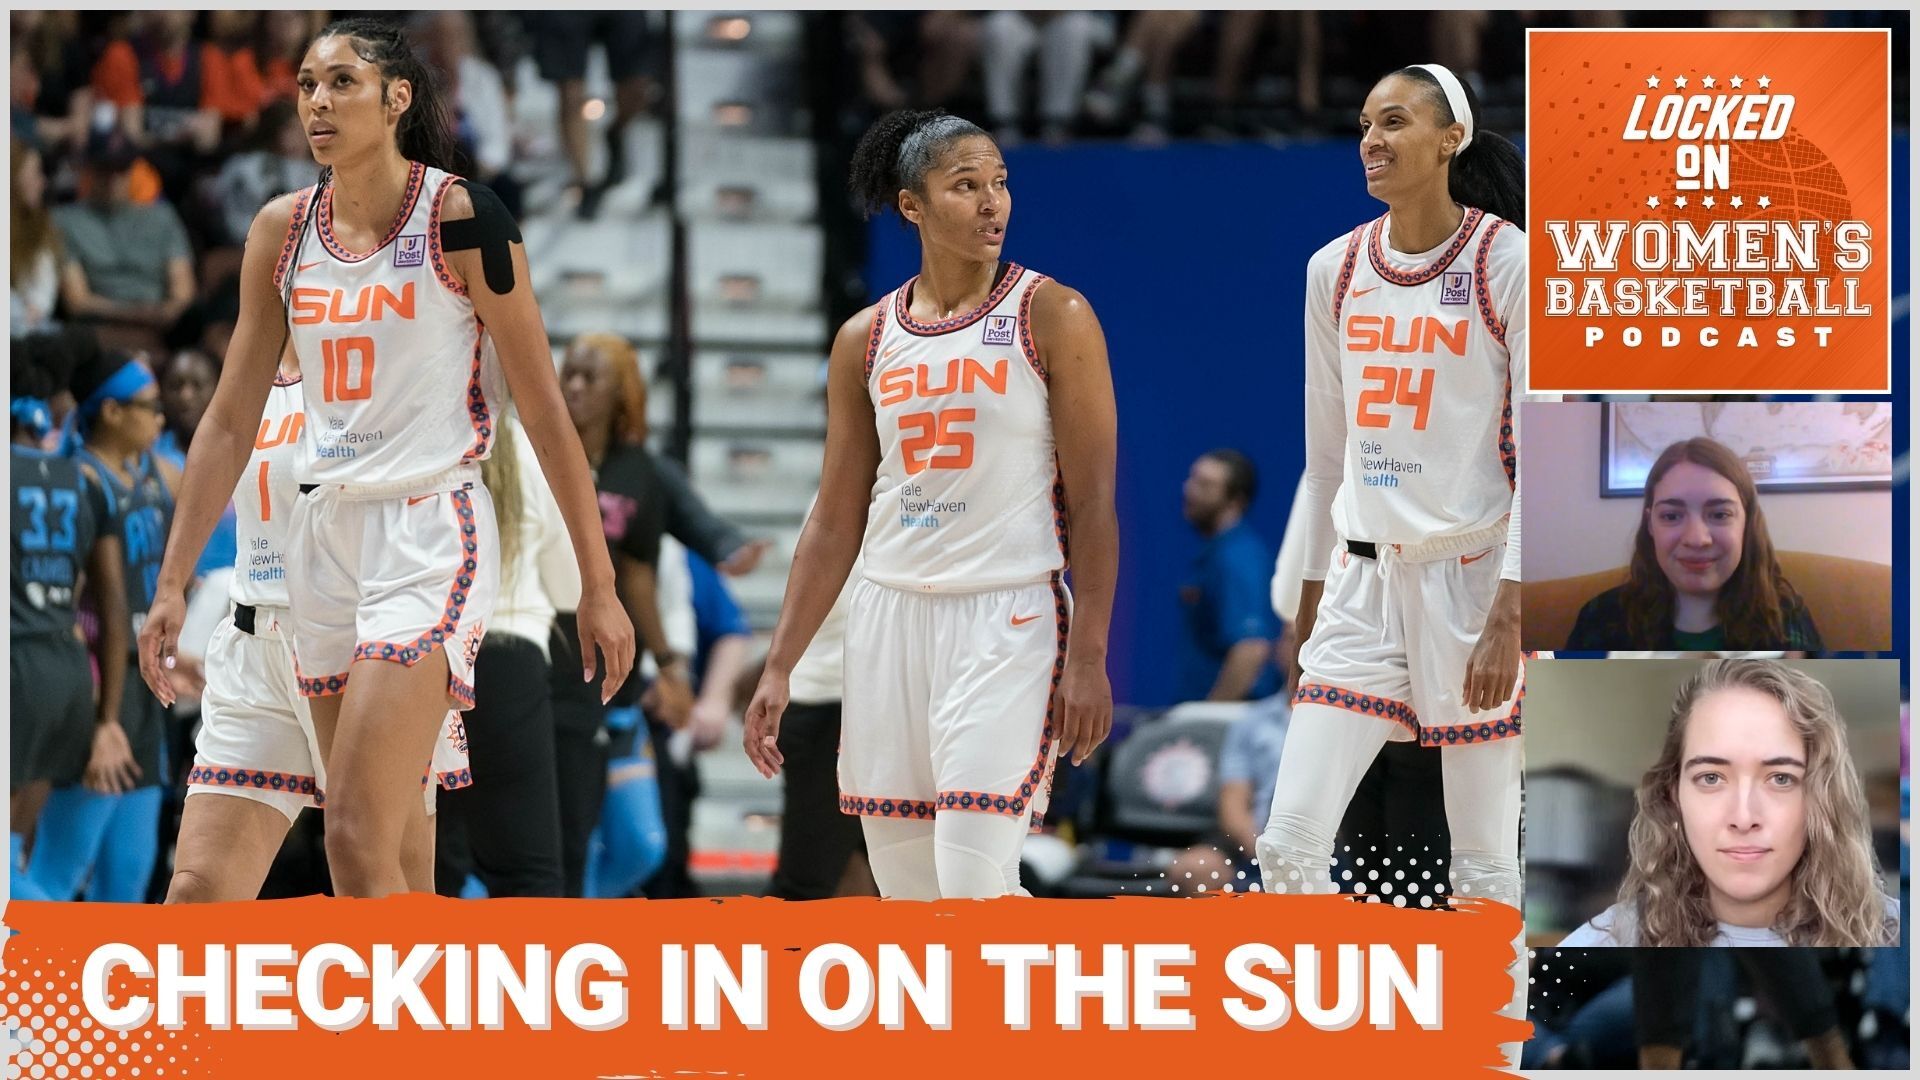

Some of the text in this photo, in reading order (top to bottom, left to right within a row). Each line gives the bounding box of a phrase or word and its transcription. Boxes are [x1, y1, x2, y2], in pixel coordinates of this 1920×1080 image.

[398, 250, 421, 260] Post
[292, 281, 415, 325] SUN
[1445, 287, 1466, 297] Post
[987, 329, 1011, 338] Post
[1347, 315, 1470, 356] SUN
[321, 336, 375, 402] 10
[879, 358, 1009, 407] SUN
[1356, 366, 1435, 430] 24
[898, 408, 976, 475] 25
[1360, 440, 1382, 454] Yale
[1360, 457, 1422, 474] NewHaven
[1363, 474, 1398, 488] Health
[18, 487, 78, 549] 33
[900, 498, 966, 512] NewHaven
